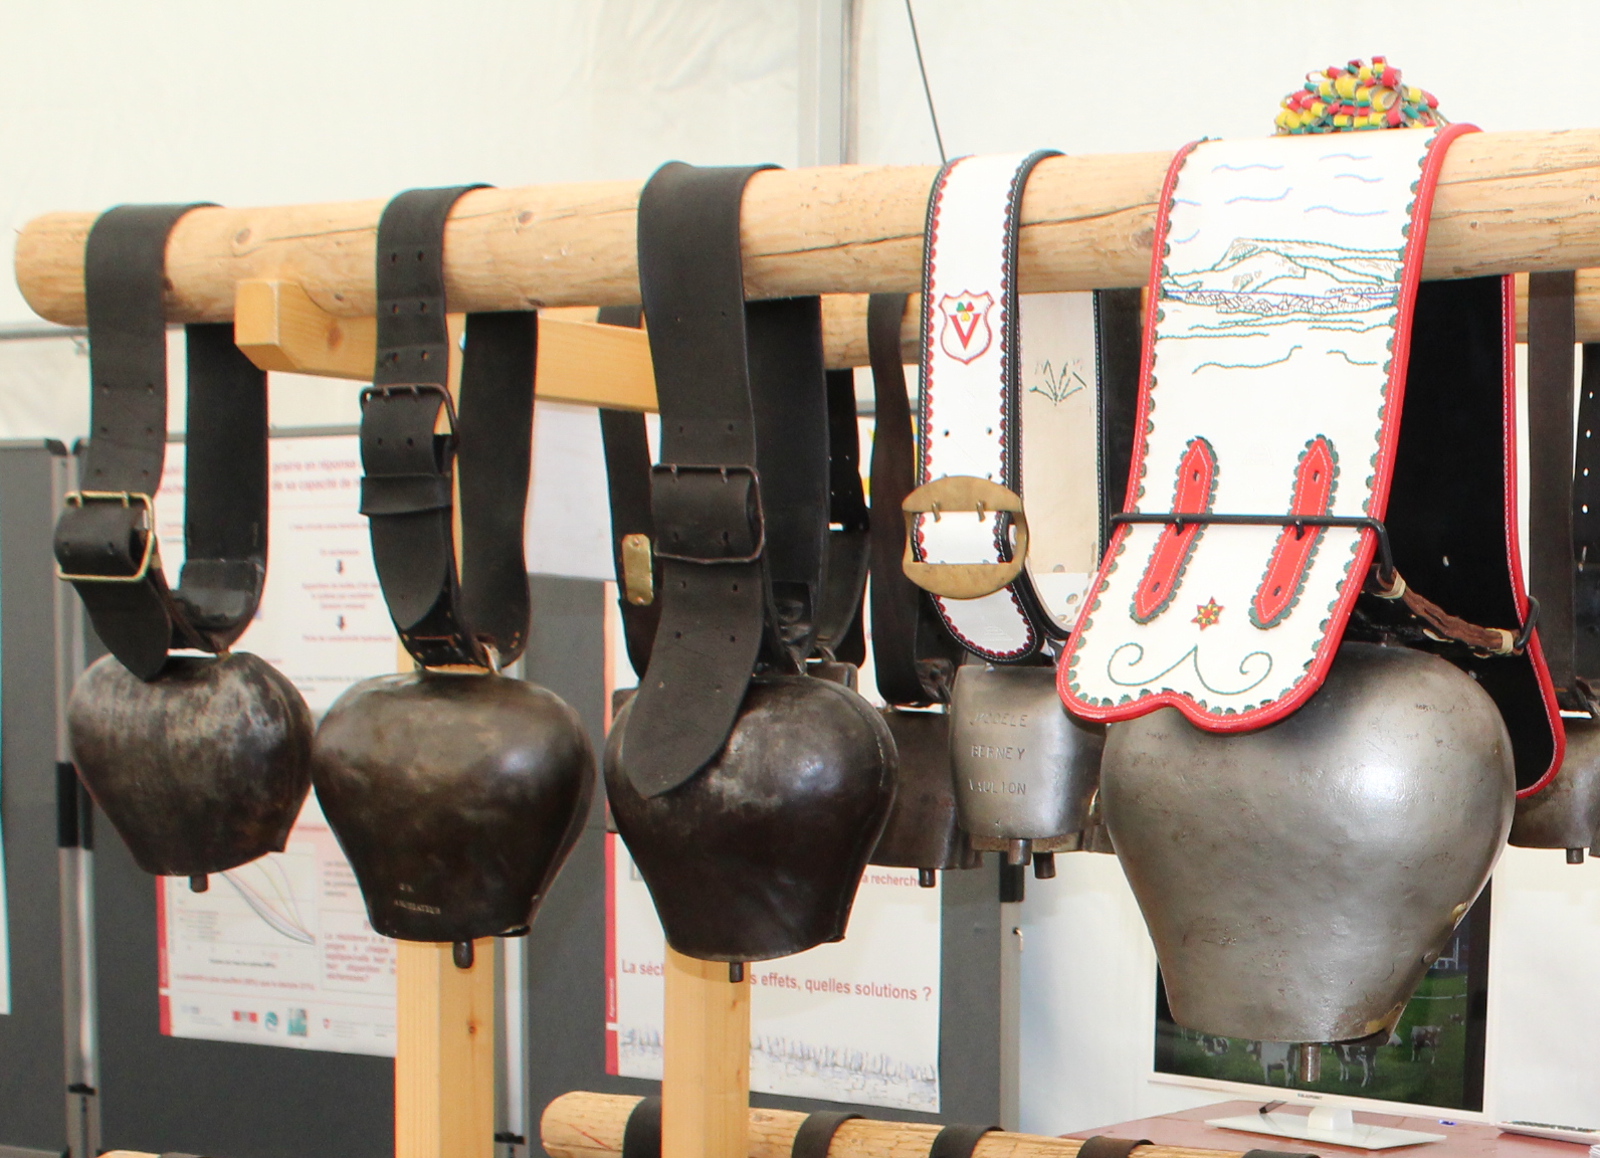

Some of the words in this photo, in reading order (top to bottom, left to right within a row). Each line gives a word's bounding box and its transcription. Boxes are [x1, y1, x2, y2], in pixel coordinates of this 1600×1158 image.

[971, 745, 1026, 760] BERNEY
[622, 959, 636, 974] La
[761, 972, 801, 991] effets,
[805, 978, 851, 994] quelles
[855, 982, 918, 1001] solutions
